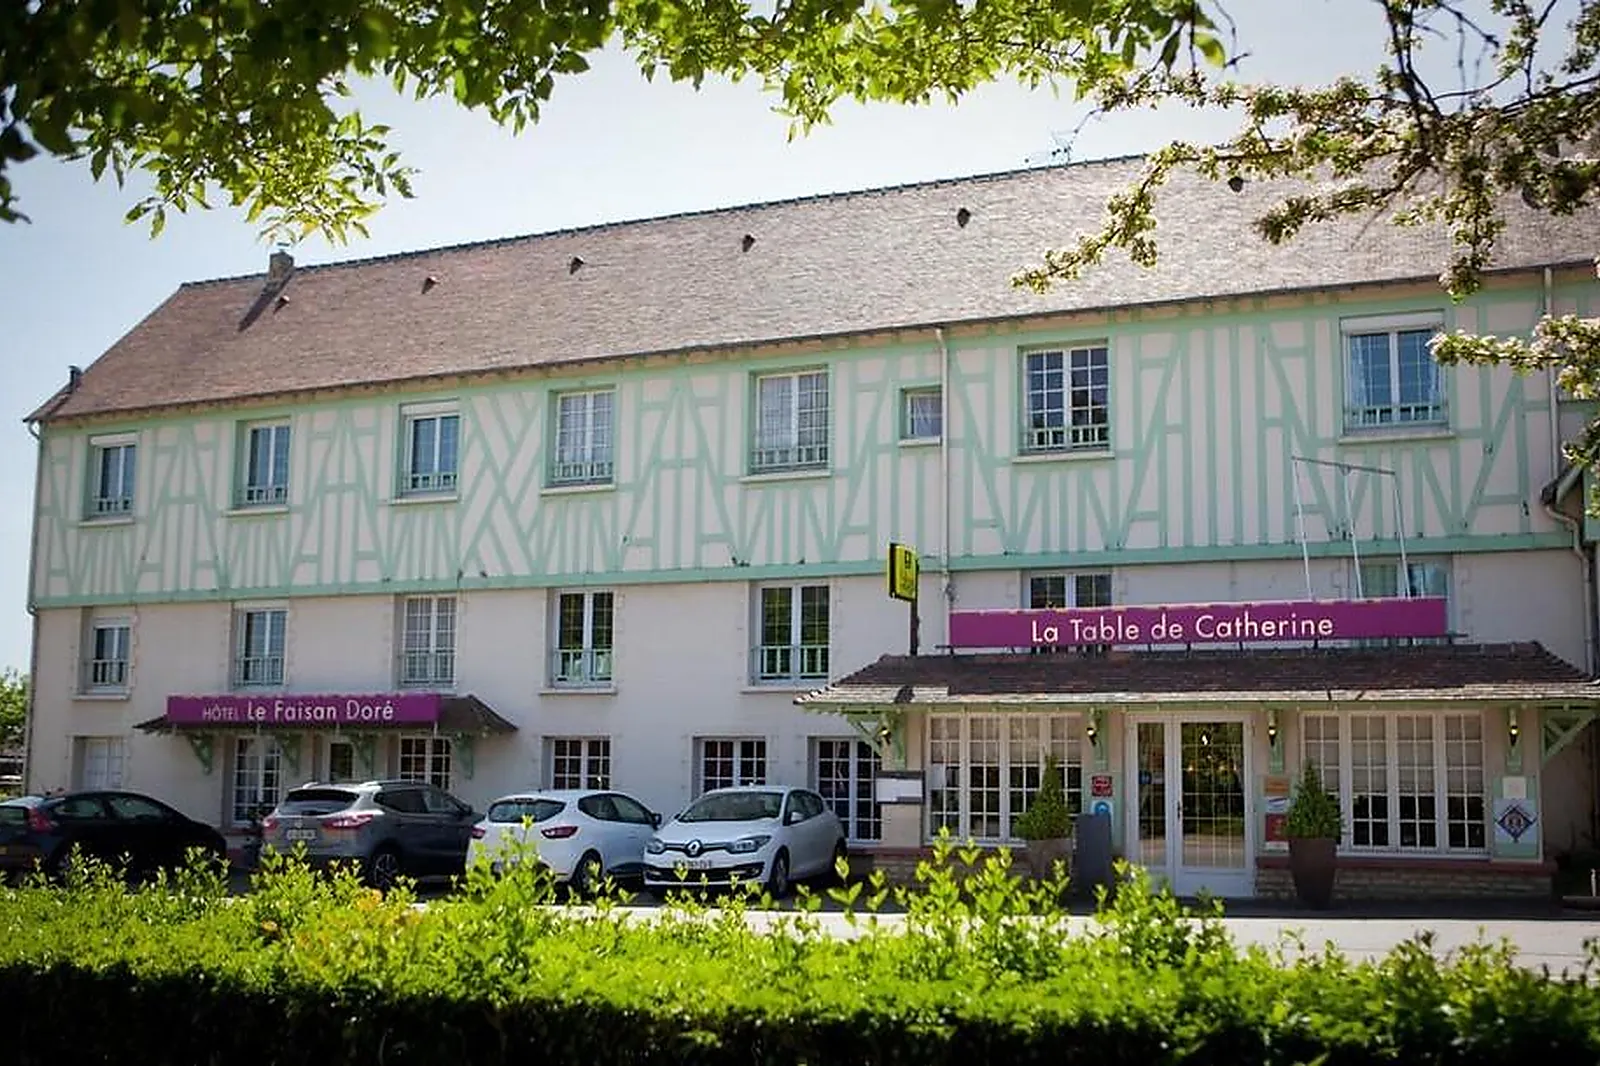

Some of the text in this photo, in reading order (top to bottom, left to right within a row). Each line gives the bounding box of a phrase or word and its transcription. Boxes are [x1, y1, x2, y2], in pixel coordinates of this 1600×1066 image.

[1031, 611, 1333, 642] La Table de Catherine
[203, 700, 394, 721] HÔTEL Le Faisan Doré
